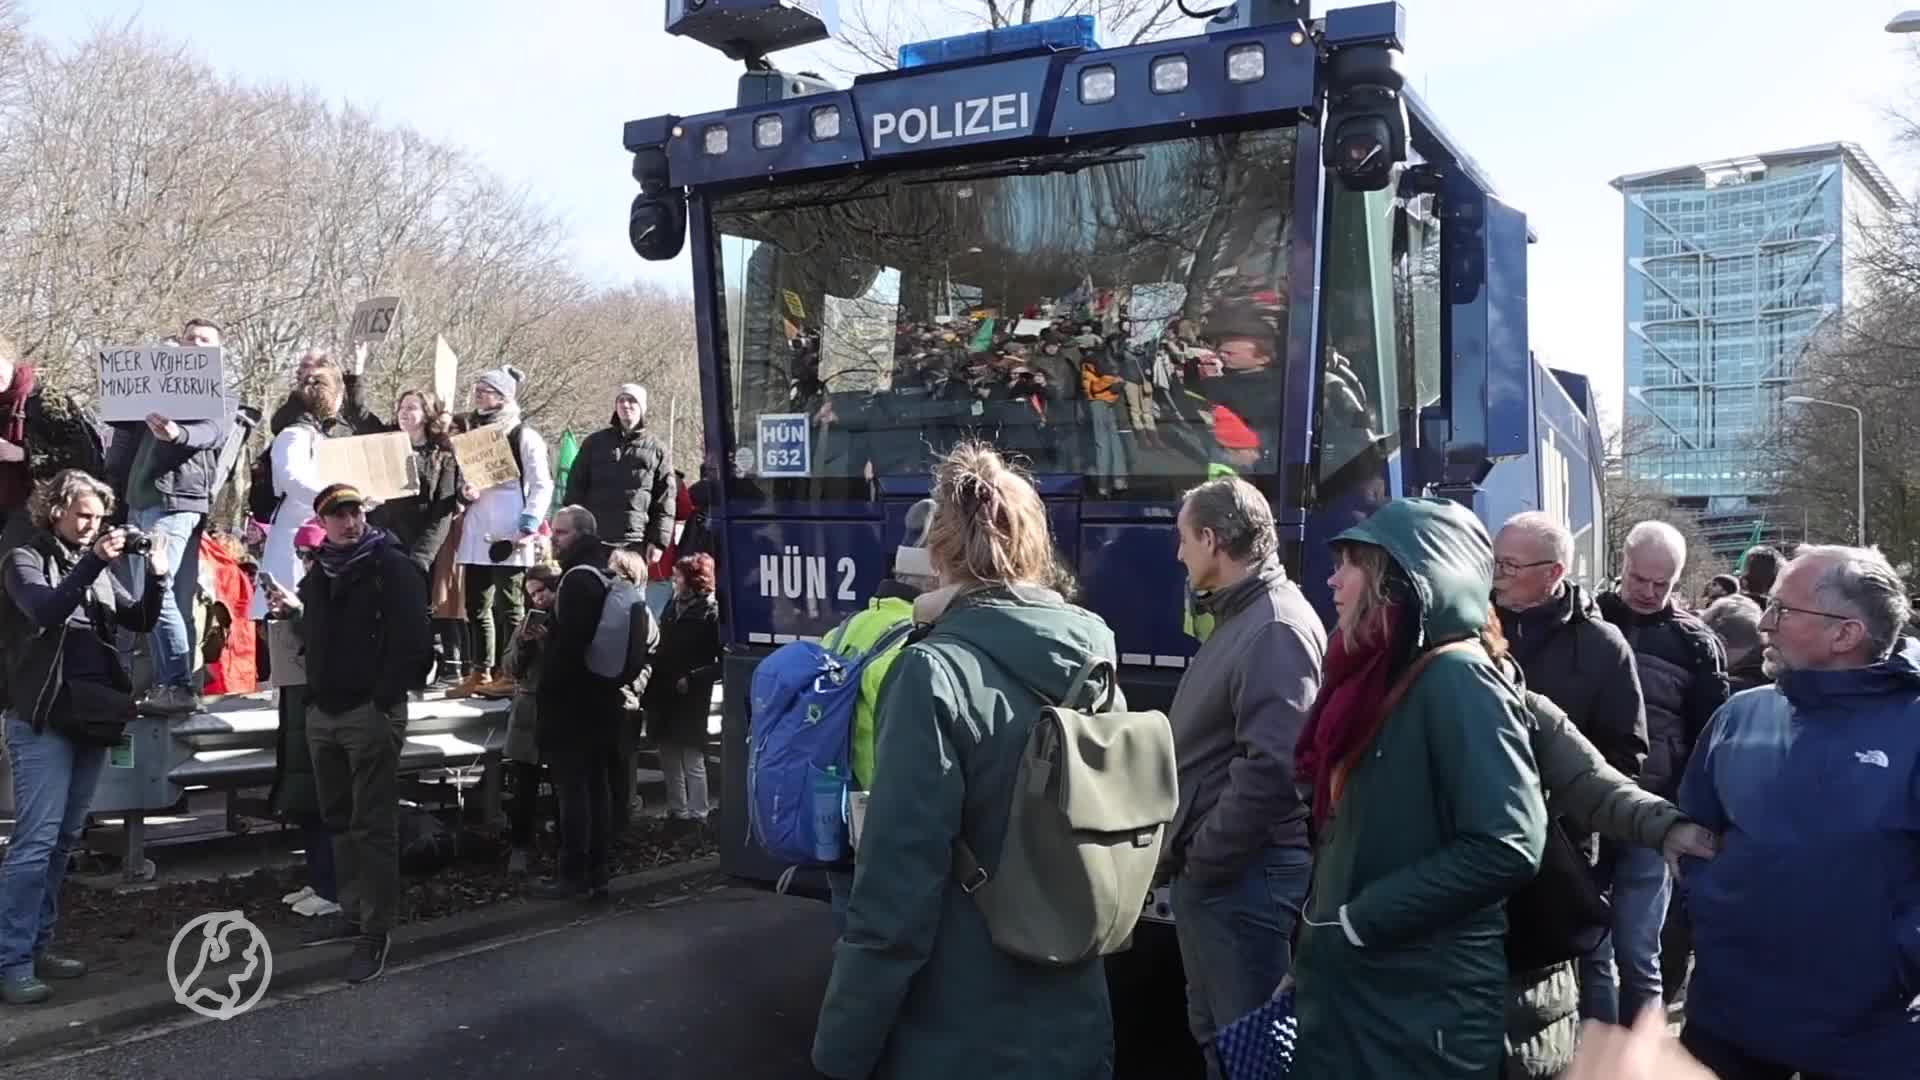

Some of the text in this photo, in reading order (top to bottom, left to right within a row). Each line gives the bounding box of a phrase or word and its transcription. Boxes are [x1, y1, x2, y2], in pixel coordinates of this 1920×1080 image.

[873, 92, 1029, 149] POLIZEI
[99, 350, 209, 375] MEER VRIJHEID
[100, 375, 222, 398] MINDER VERBRUIK
[762, 422, 804, 443] HÜN
[766, 449, 801, 466] 632
[760, 545, 856, 600] HÜN 2
